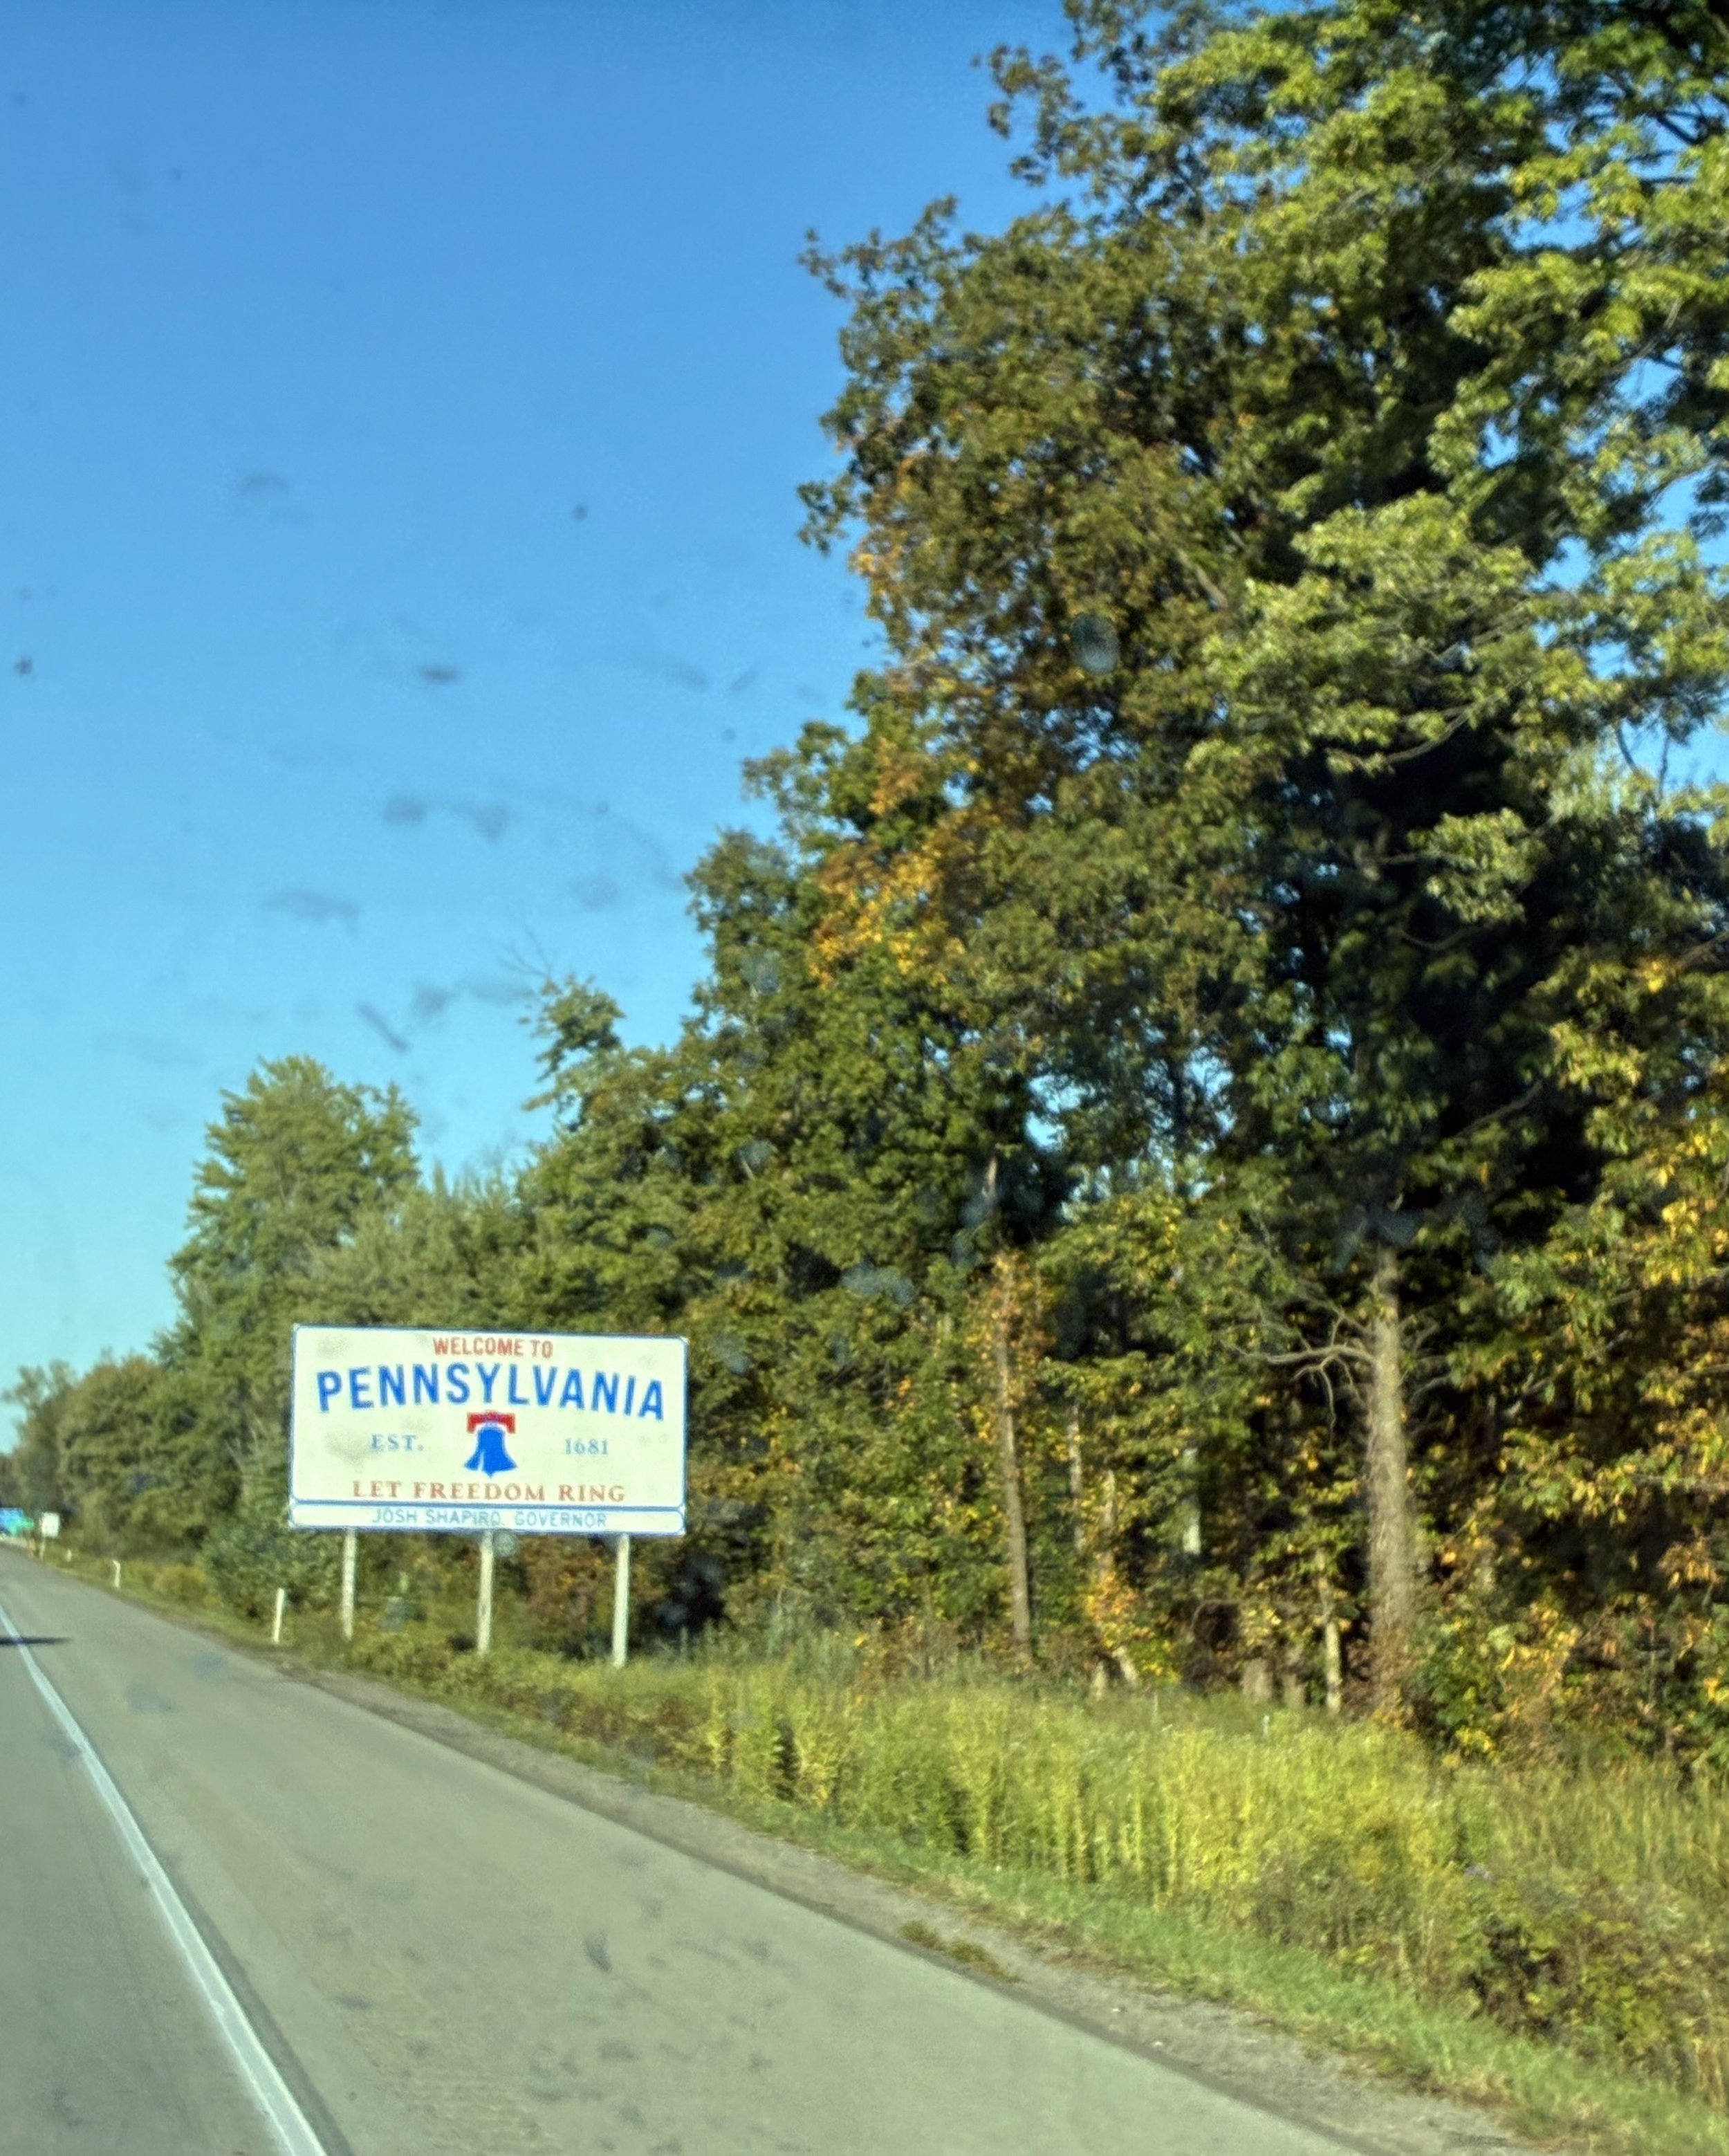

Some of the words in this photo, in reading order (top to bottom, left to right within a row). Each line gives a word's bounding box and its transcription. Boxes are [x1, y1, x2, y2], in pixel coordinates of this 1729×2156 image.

[433, 1336, 523, 1357] WELCOME
[533, 1340, 553, 1358] TO
[317, 1363, 664, 1420] PENNSYLVANIA
[371, 1434, 424, 1451] EST.
[564, 1438, 608, 1455] 1681
[353, 1480, 403, 1498] LET
[413, 1482, 545, 1501] FREEDOM
[559, 1484, 625, 1502] RING
[371, 1508, 418, 1524] JOSH
[514, 1510, 607, 1527] GOVERNOR
